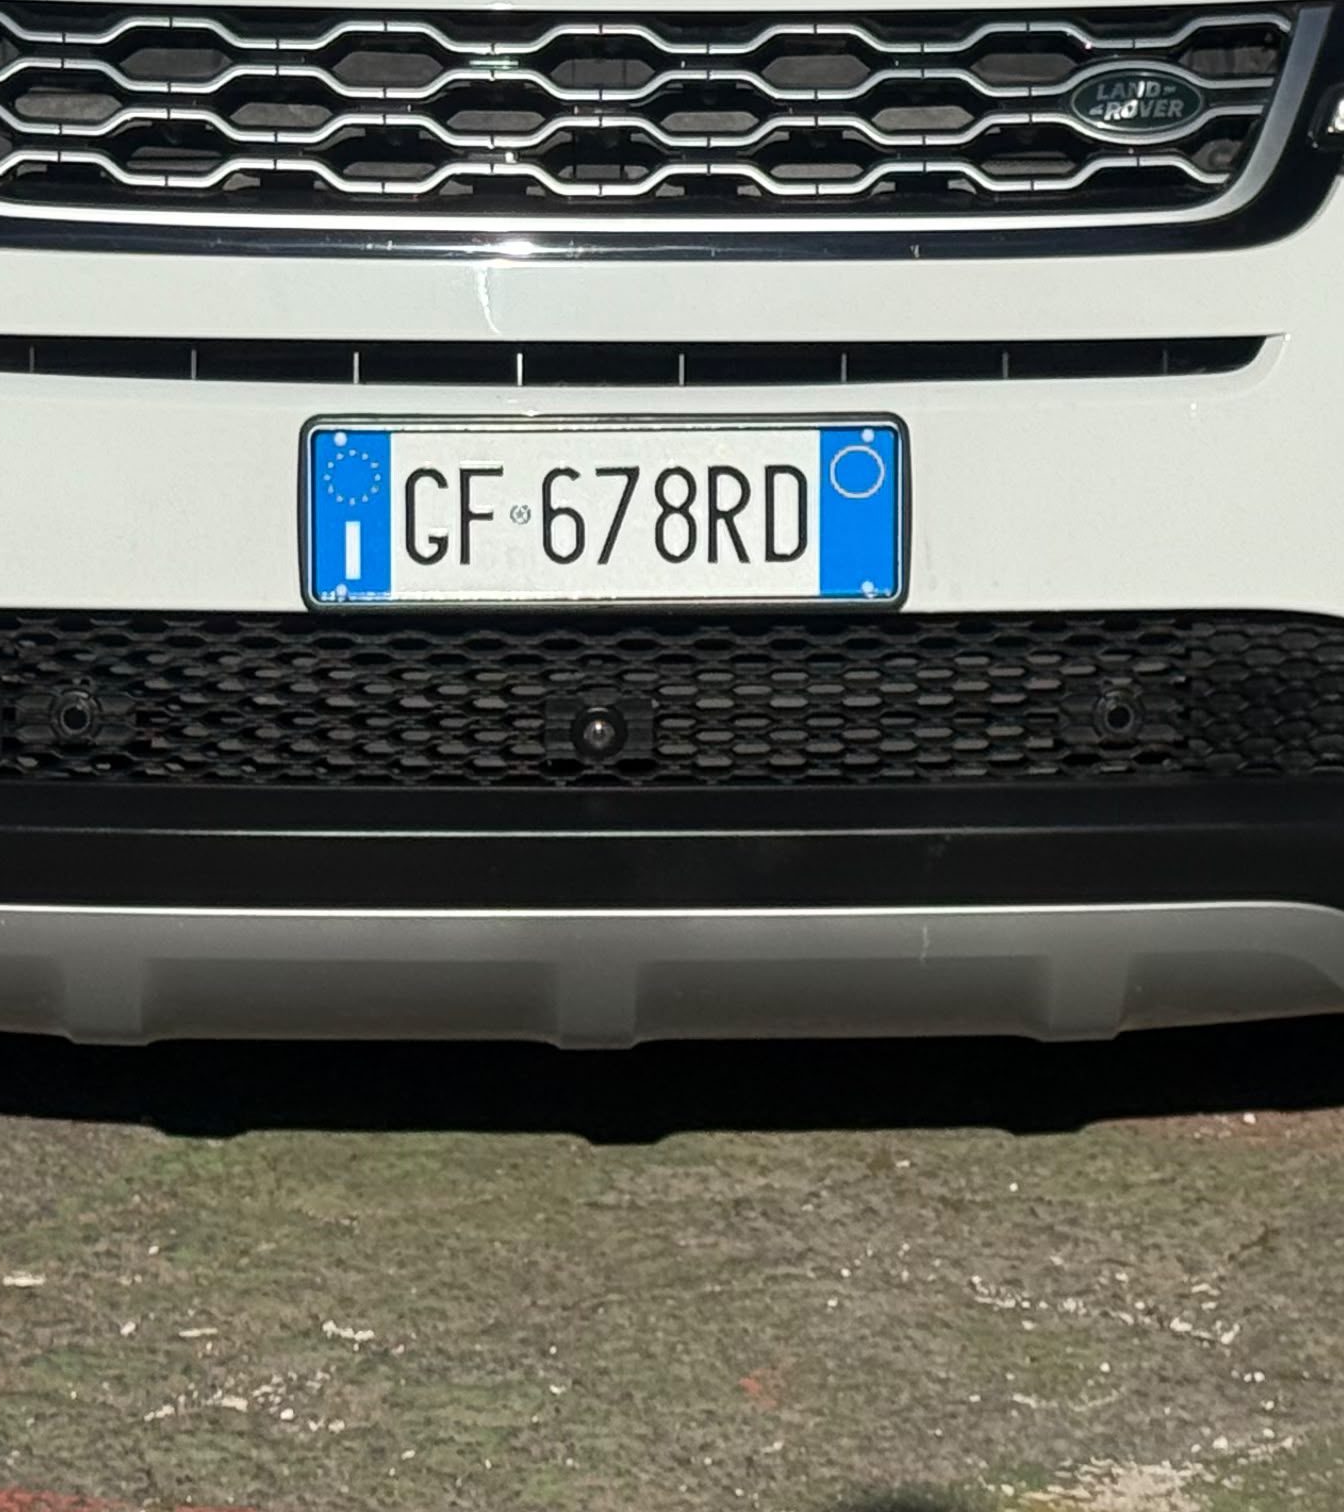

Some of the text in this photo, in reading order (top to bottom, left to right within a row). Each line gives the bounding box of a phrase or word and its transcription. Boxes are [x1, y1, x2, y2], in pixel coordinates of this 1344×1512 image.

[1095, 80, 1161, 101] LAND
[1103, 99, 1186, 121] ROVER
[403, 459, 809, 566] GF 678RD
